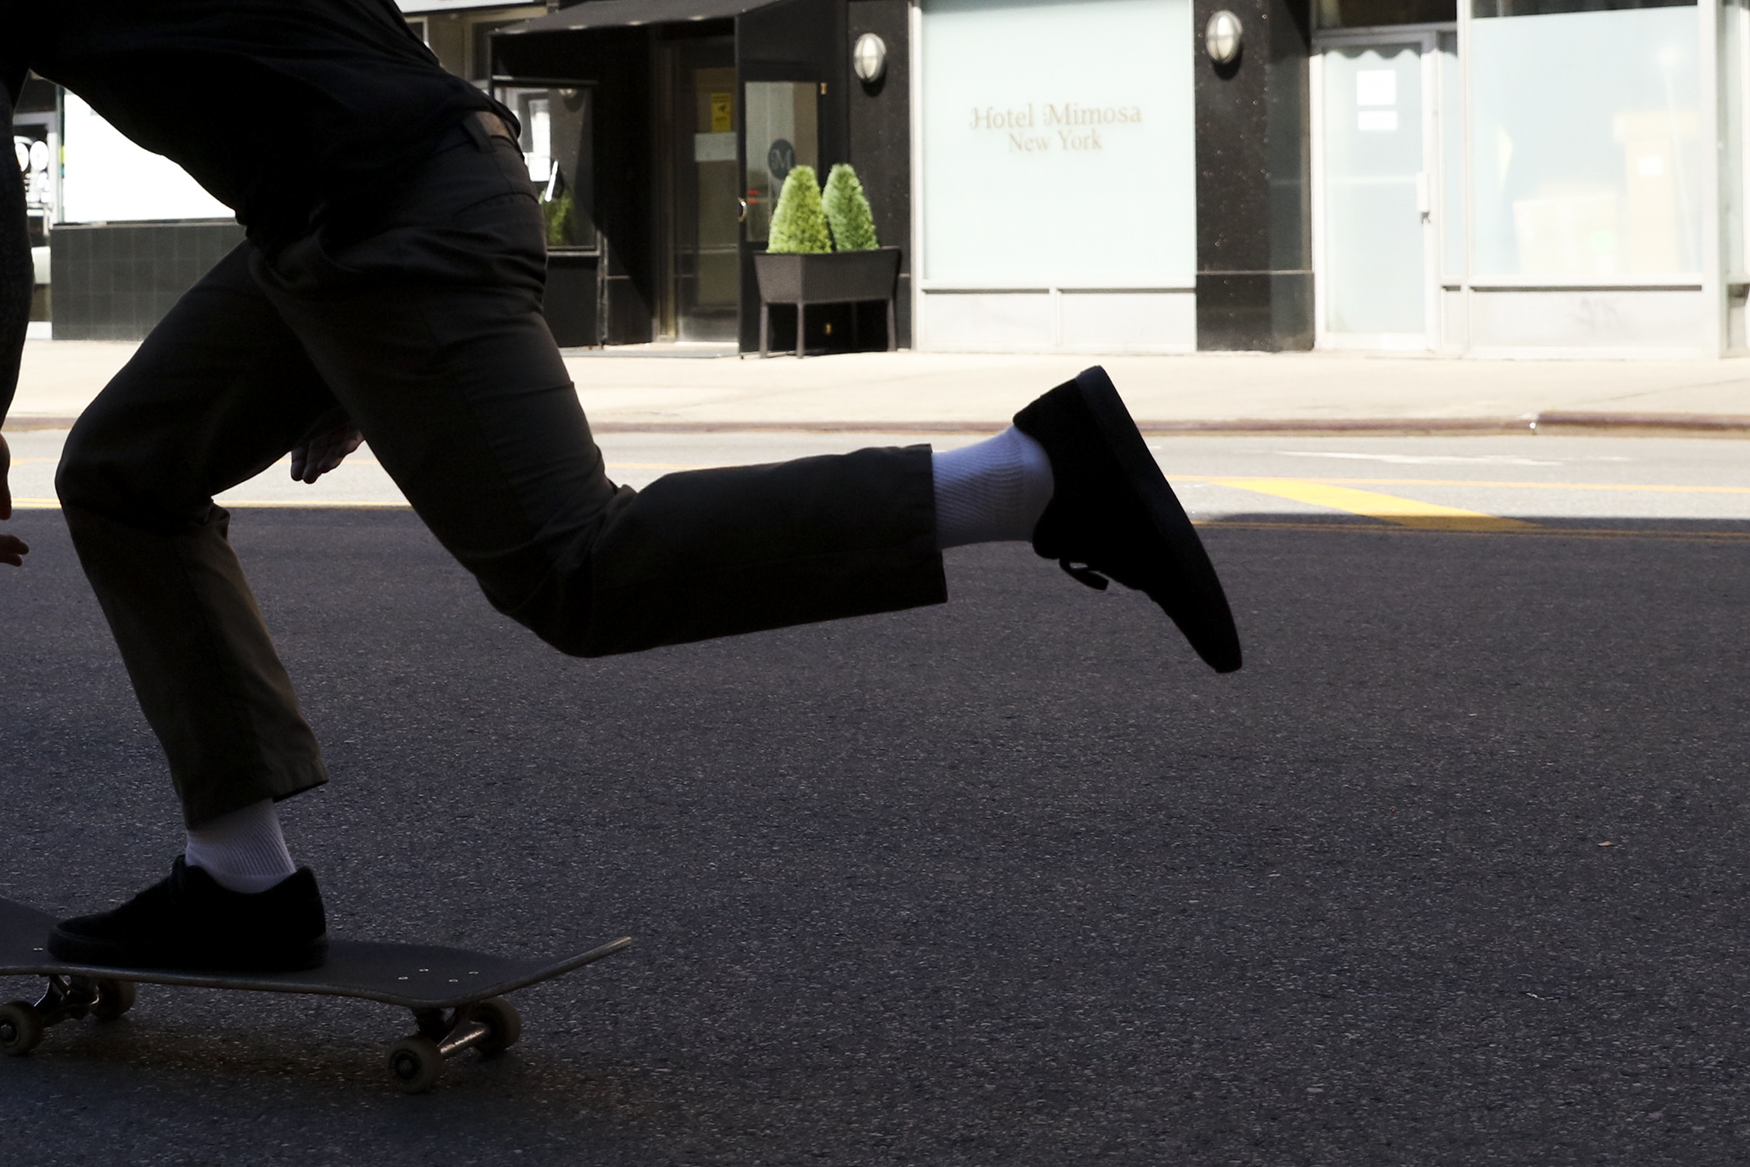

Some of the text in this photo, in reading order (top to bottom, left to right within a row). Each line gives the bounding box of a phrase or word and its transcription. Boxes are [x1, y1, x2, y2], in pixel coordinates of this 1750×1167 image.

[968, 102, 1143, 131] Hotel Mimosa
[1007, 128, 1103, 153] New York
